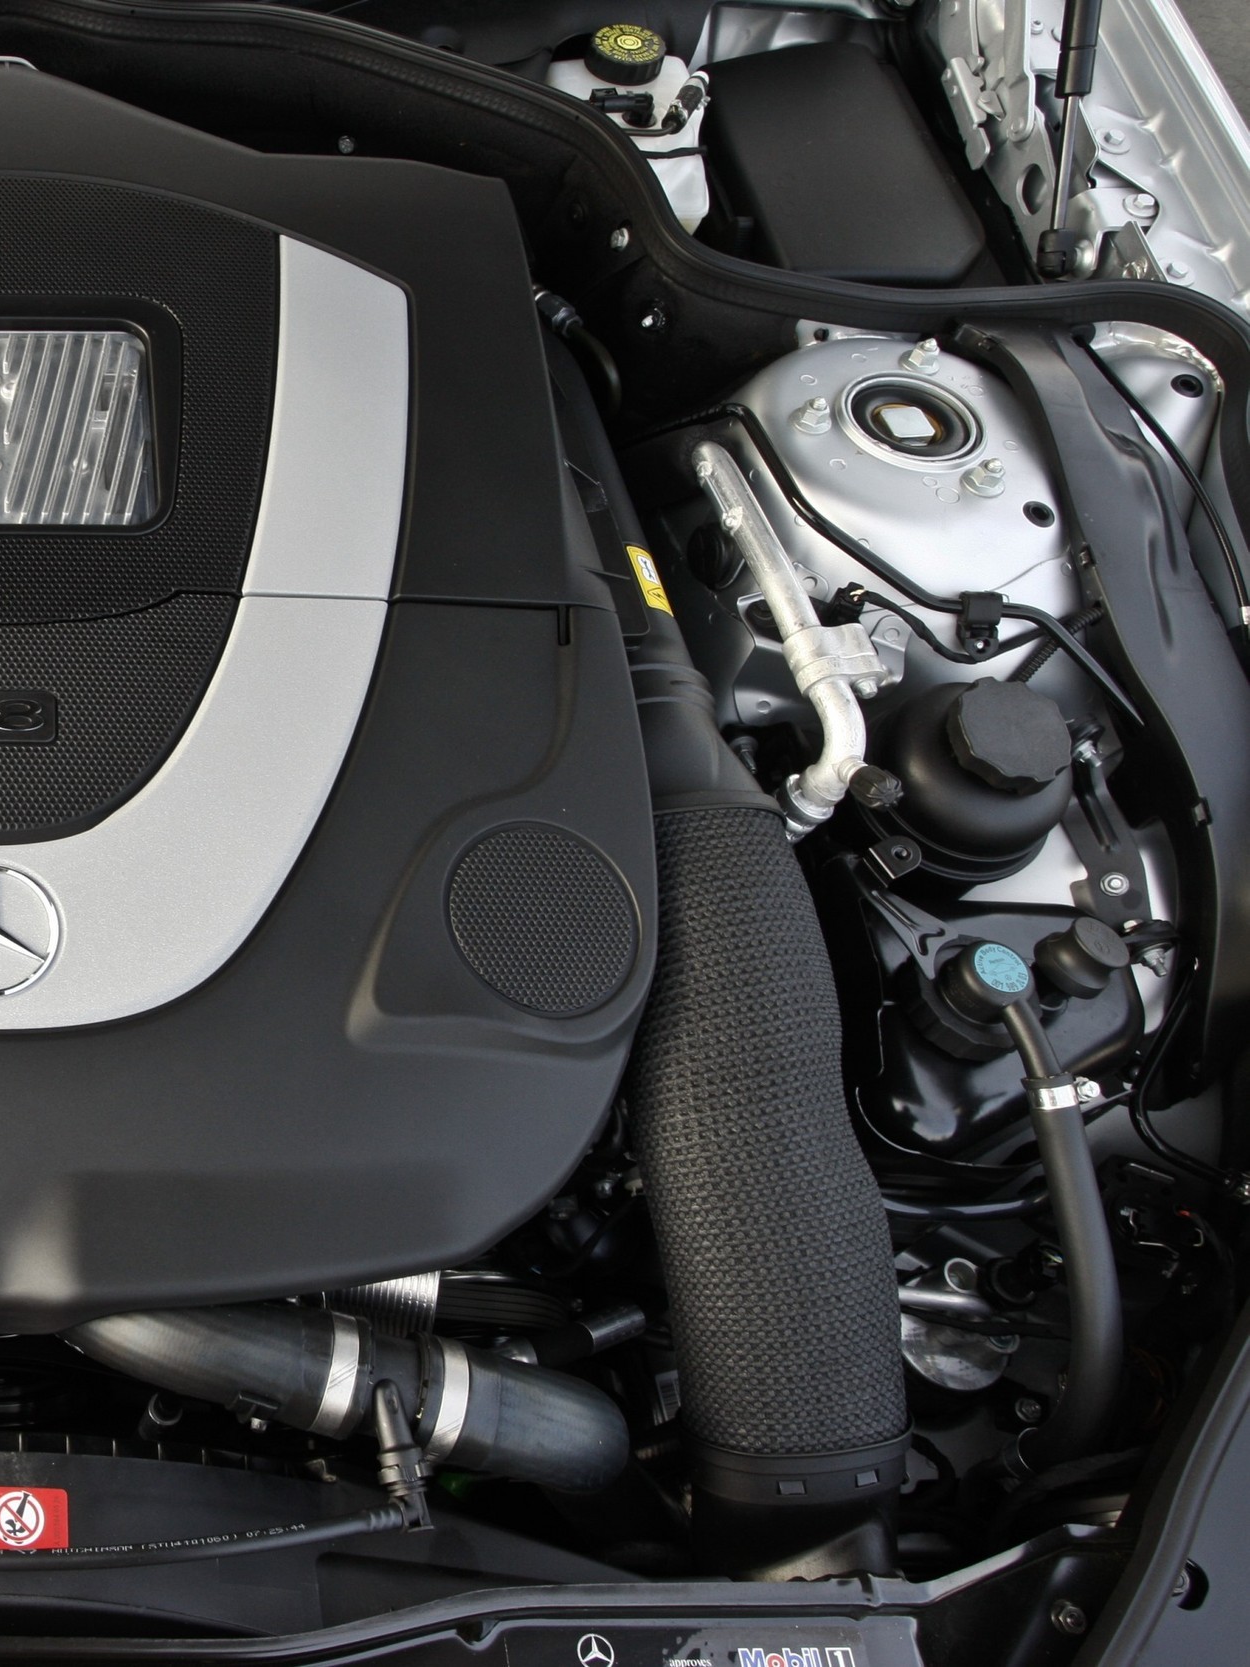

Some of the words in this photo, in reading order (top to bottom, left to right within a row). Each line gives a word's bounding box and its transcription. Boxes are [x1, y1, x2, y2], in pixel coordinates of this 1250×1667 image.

[980, 947, 996, 956] Body
[997, 946, 1021, 966] Control
[977, 955, 987, 975] Active
[669, 1658, 712, 1667] approves
[738, 1647, 822, 1667] Mobil
